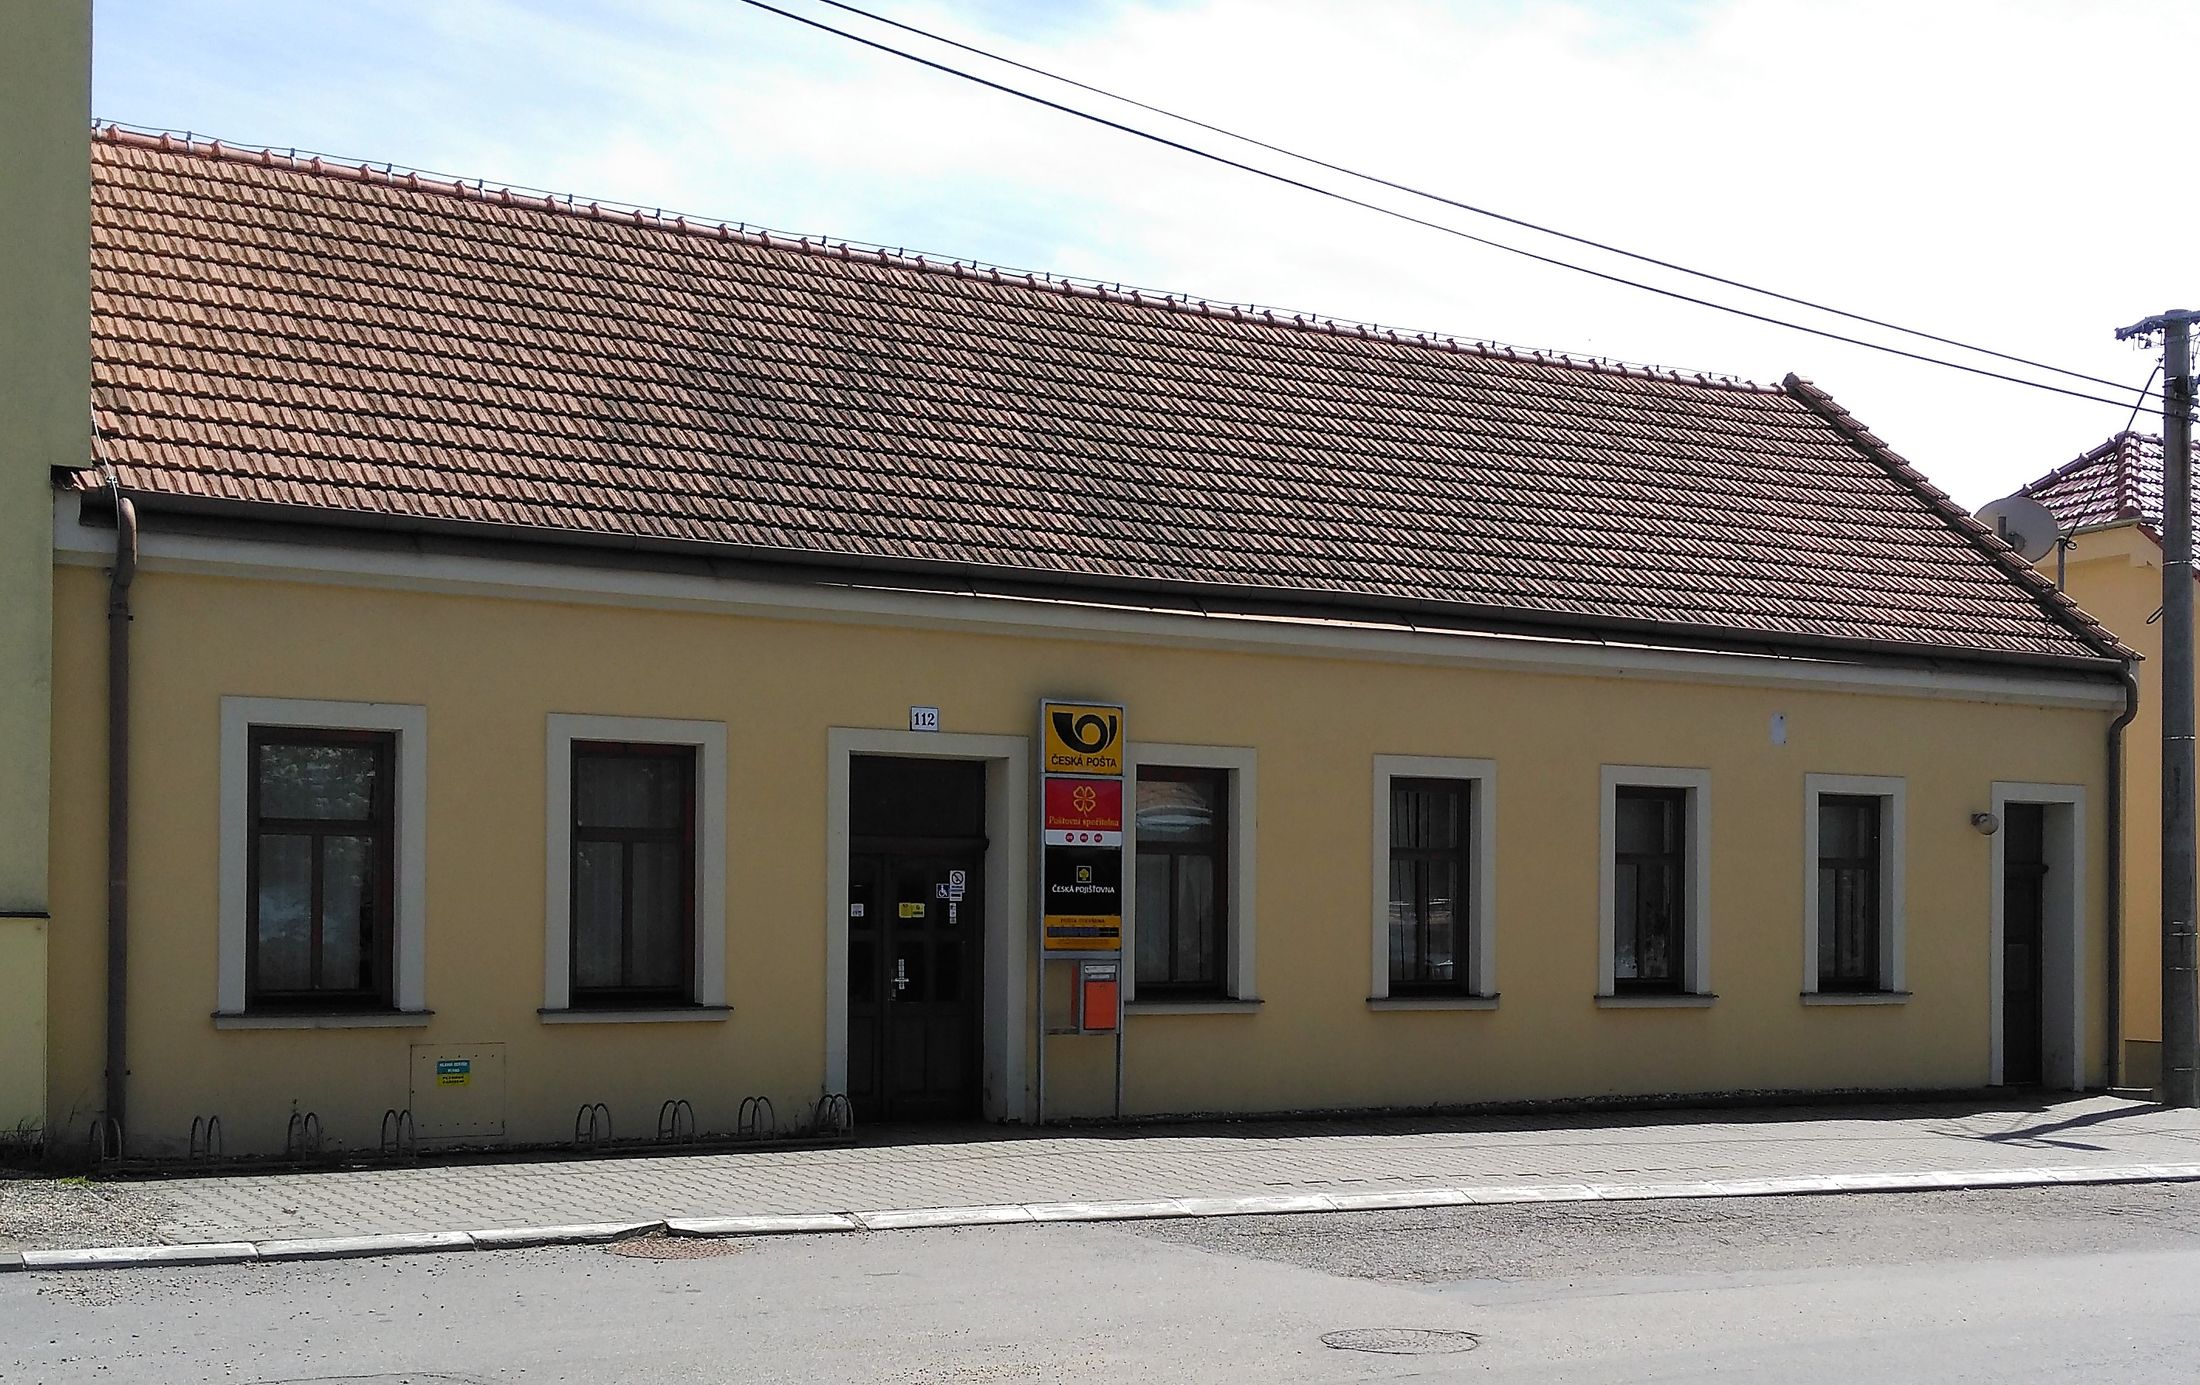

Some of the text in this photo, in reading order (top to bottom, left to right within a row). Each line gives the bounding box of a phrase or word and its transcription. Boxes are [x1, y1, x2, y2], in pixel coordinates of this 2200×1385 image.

[914, 711, 935, 726] 112
[1051, 753, 1117, 768] ČESKÁ POŠTA
[1051, 883, 1115, 894] ČESKÁ POJIŠŤOVNA
